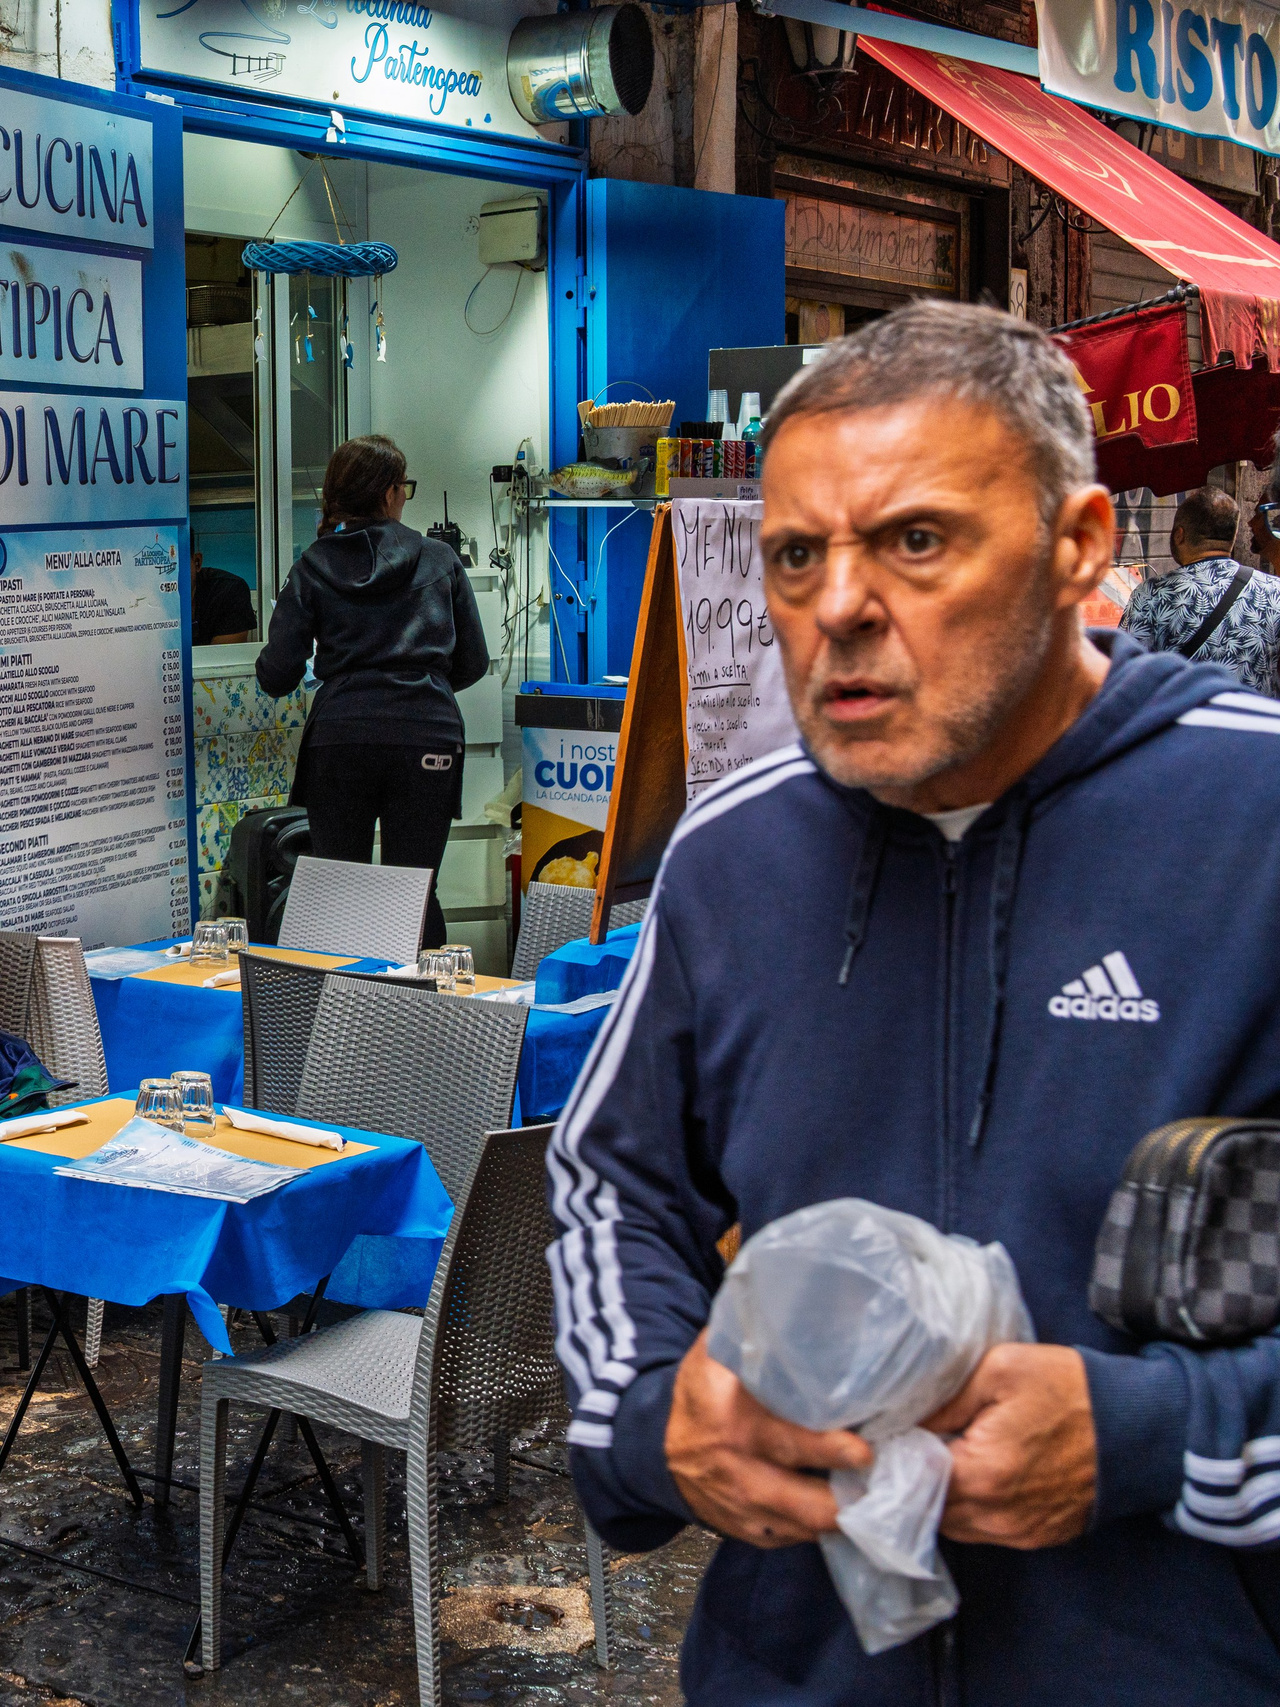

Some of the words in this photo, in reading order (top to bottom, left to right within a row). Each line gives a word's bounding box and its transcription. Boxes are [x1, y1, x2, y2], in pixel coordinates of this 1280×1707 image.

[351, 22, 482, 116] Partenopea
[1086, 383, 1182, 440] LIO
[44, 405, 180, 486] MARE
[45, 553, 72, 570] MENU'
[73, 552, 94, 568] ALLA
[95, 551, 122, 567] CARTA
[134, 556, 171, 566] PARTENOPEA
[16, 594, 22, 603] DI
[23, 593, 37, 603] MARE
[43, 591, 65, 601] PORTATE
[65, 590, 69, 600] A
[20, 603, 44, 614] CLASSICA,
[45, 601, 75, 612] BRUSCHETTA
[75, 600, 87, 610] ALLA
[11, 616, 15, 626] E
[42, 613, 54, 623] ALICI
[80, 610, 96, 620] POLPO
[10, 653, 33, 666] PIATTI
[25, 668, 38, 677] ALLO
[38, 665, 60, 675] SCOGLIO
[14, 693, 27, 702] ALLO
[28, 690, 49, 701] SCOGLIO
[13, 705, 26, 715] ALLA
[26, 701, 55, 713] PESCATORA
[16, 716, 23, 726] AL
[24, 713, 49, 725] BACCALA'
[20, 737, 33, 747] ALLA
[33, 734, 54, 745] NERANO
[54, 733, 60, 742] DI
[61, 731, 75, 741] MARE
[20, 749, 33, 759] ALLE
[34, 746, 57, 757] VONGOLE
[57, 743, 75, 754] VERACI
[571, 744, 616, 762] nost
[21, 761, 32, 772] CON
[33, 756, 62, 770] GAMBERONI
[62, 756, 68, 765] DI
[68, 752, 91, 764] MAZZARA
[20, 795, 31, 805] CON
[536, 790, 548, 800] LA
[549, 791, 594, 804] LOCANDA
[596, 794, 612, 805] PA
[28, 834, 49, 849] PIATTI
[24, 913, 30, 923] DI
[30, 910, 45, 922] MARE
[31, 921, 48, 934] POLPO
[1048, 993, 1161, 1023] adidas
